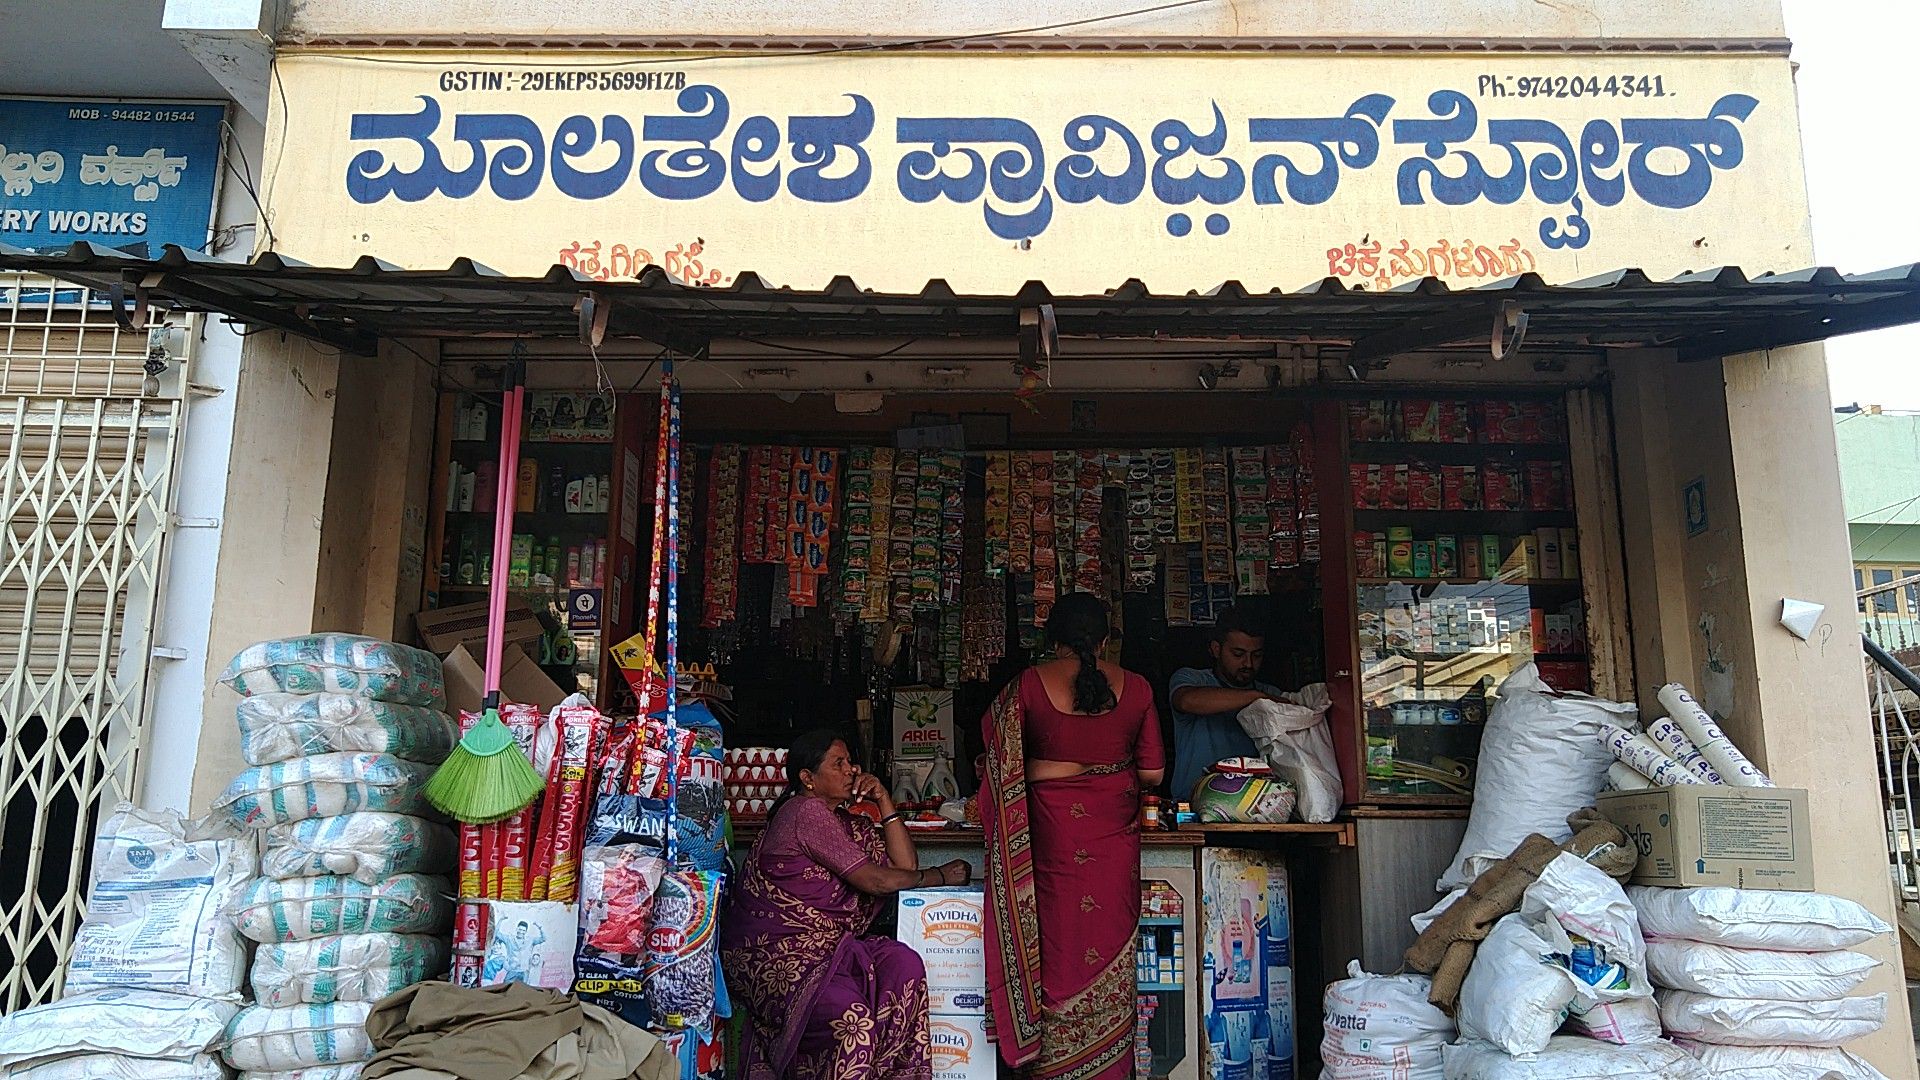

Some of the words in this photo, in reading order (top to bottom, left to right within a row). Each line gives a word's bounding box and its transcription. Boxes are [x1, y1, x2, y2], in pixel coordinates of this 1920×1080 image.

[69, 109, 99, 120] MOB
[112, 110, 151, 121] 94482
[155, 111, 195, 122] 01544
[346, 84, 875, 204] ಮಾಲತೇಶ
[1393, 89, 1760, 250] ಸ್ಟೋರ್
[0, 209, 41, 231] RY
[49, 210, 147, 235] WORKS
[572, 613, 598, 621] PhonePe
[506, 715, 537, 724] MONKEY
[902, 730, 946, 741] ARIEL
[615, 814, 664, 837] SWAN
[927, 910, 978, 923] VIVIDHA
[650, 933, 680, 947] SLM
[577, 981, 604, 991] CLIP
[614, 990, 645, 1000] COTTON
